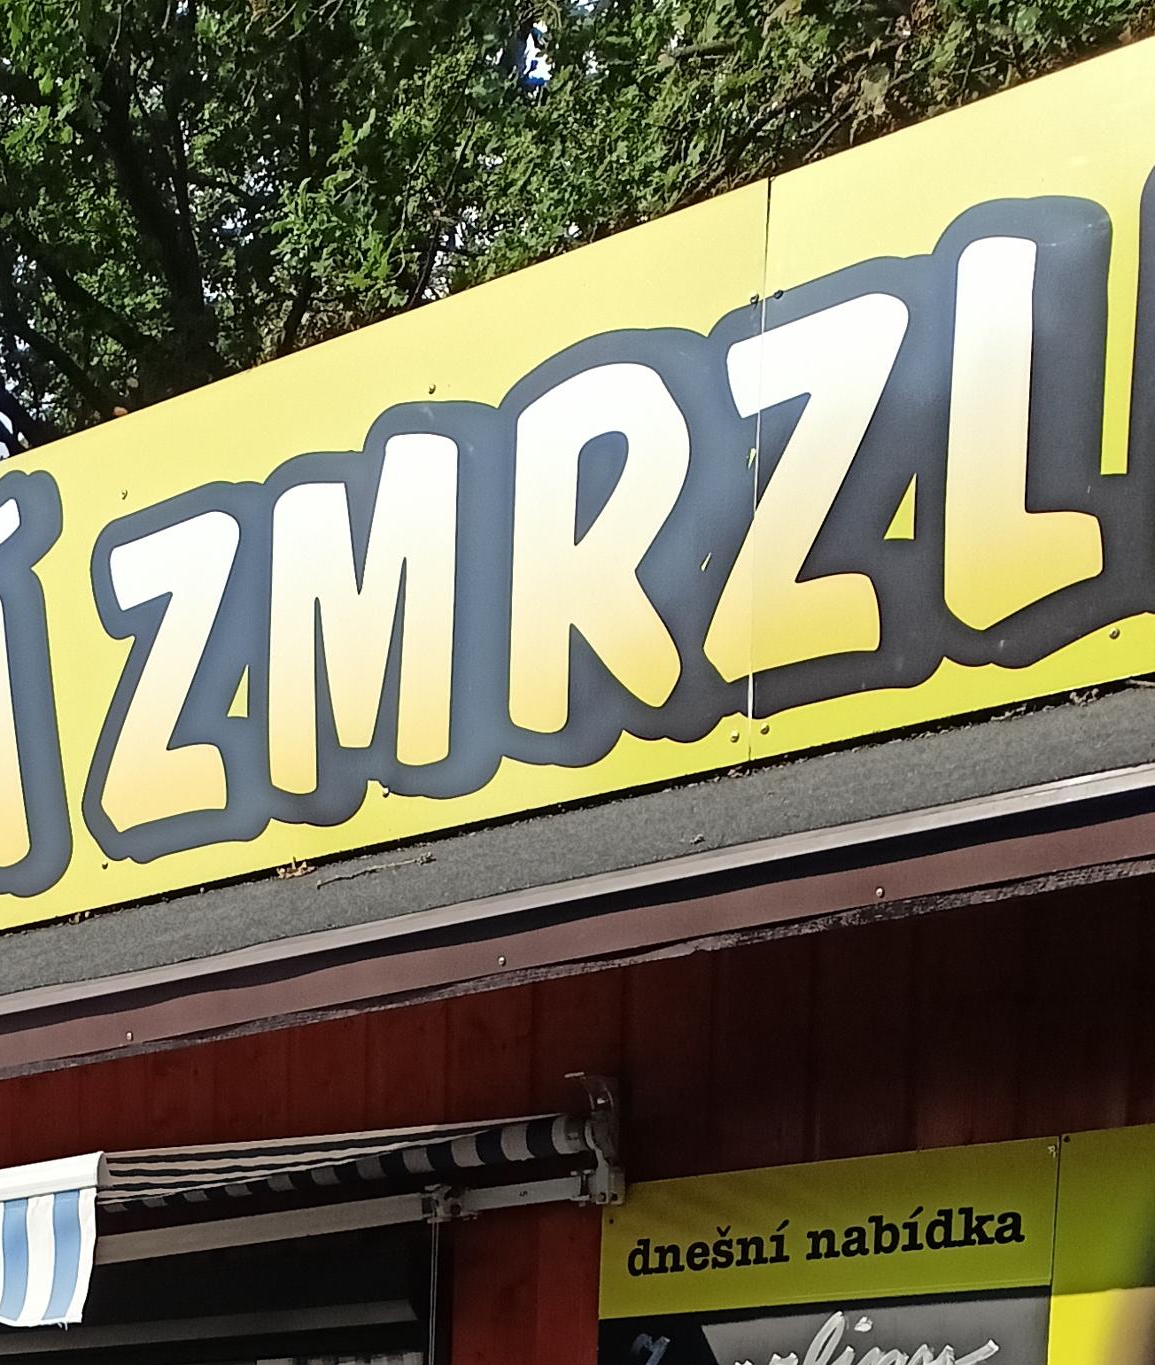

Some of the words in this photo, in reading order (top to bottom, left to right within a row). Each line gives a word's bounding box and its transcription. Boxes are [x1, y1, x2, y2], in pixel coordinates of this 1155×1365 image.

[90, 195, 1155, 850] ZMRZL
[626, 1220, 790, 1277] dnešní
[806, 1206, 1026, 1261] nabídka
